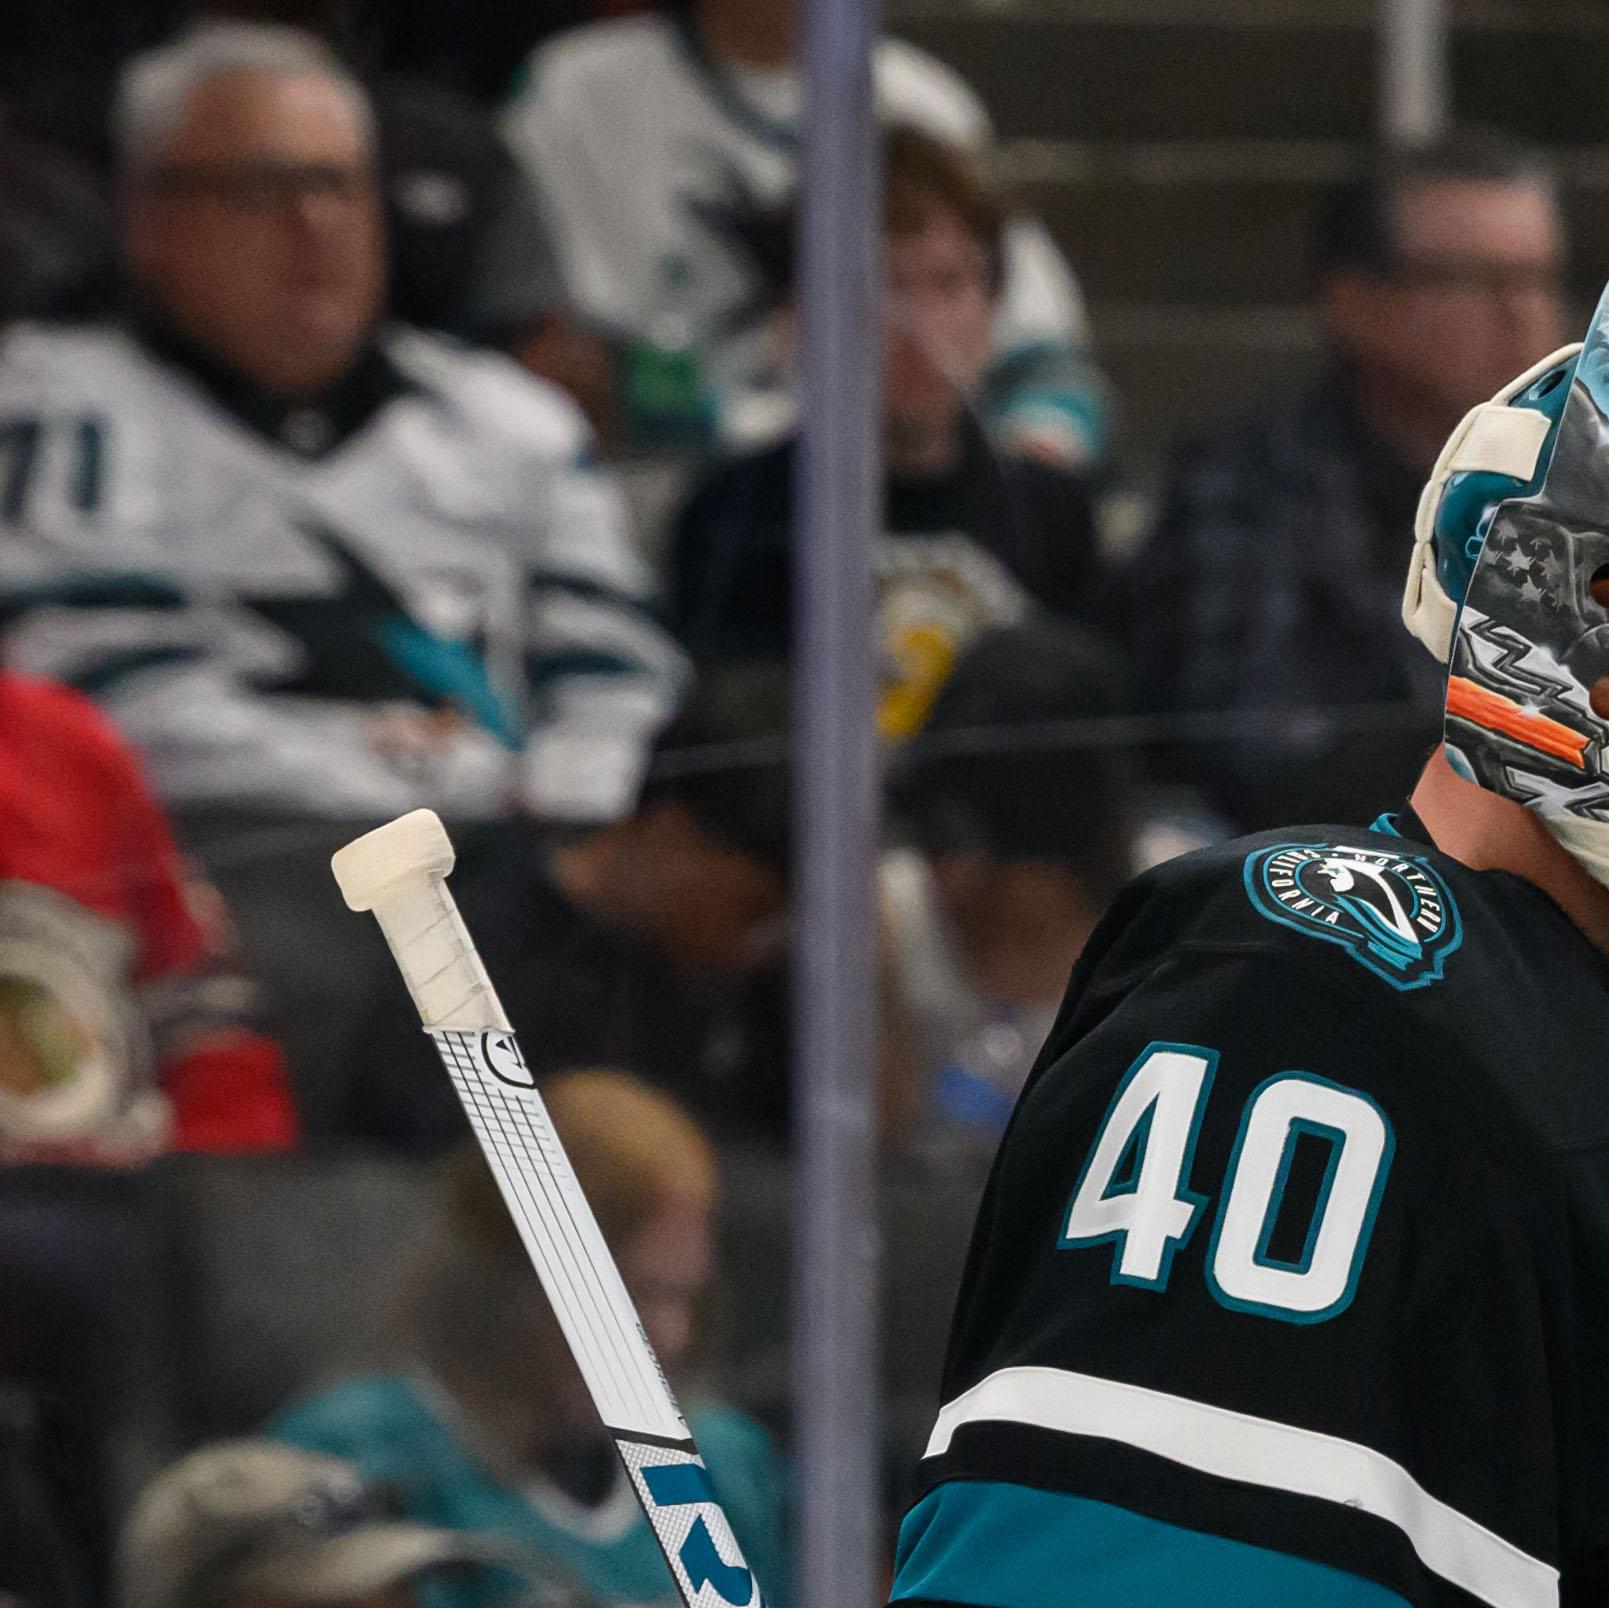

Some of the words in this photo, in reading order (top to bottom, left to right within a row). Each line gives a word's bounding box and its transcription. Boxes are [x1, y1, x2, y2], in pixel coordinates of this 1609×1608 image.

[1269, 849, 1342, 925] CALIFORNIA
[1355, 854, 1442, 933] NORTHERN
[1057, 1041, 1396, 1325] 40
